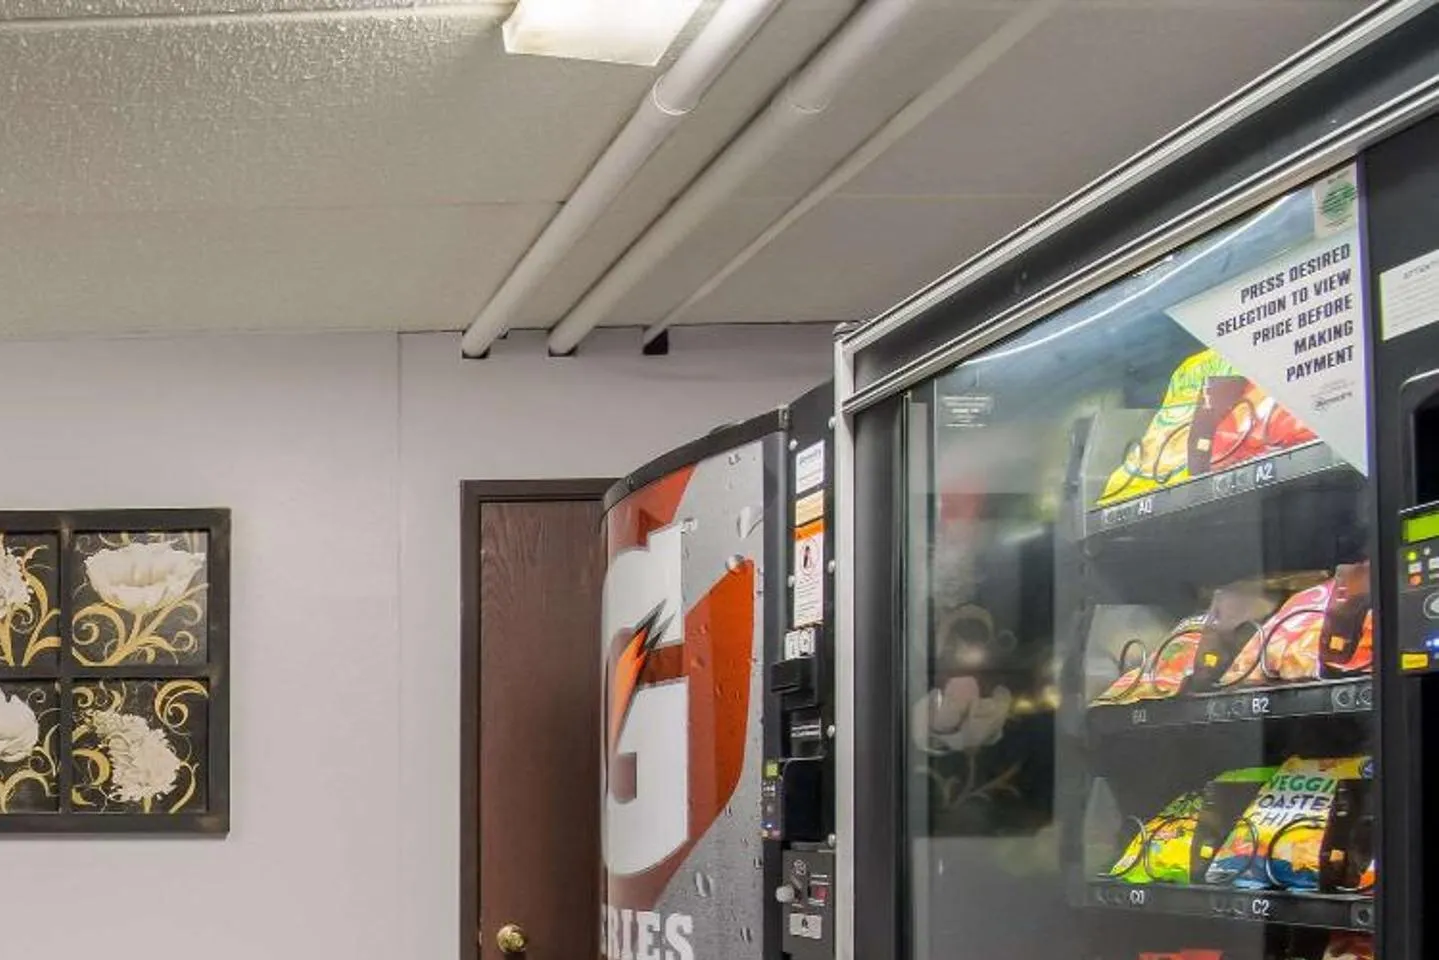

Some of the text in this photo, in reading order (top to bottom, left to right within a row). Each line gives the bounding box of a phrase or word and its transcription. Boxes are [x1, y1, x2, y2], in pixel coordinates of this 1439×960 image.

[1241, 243, 1350, 304] PRESS DESIRED
[1216, 268, 1352, 337] SELECTION TO VIEW
[1253, 318, 1293, 346] PRICE
[1298, 294, 1353, 329] BEFORE
[1294, 320, 1354, 355] MAKING
[1286, 345, 1354, 383] PAYMENT
[1255, 464, 1273, 484] A2
[1252, 698, 1270, 713] B2
[1258, 793, 1330, 811] OASTE
[1252, 899, 1270, 916] C2
